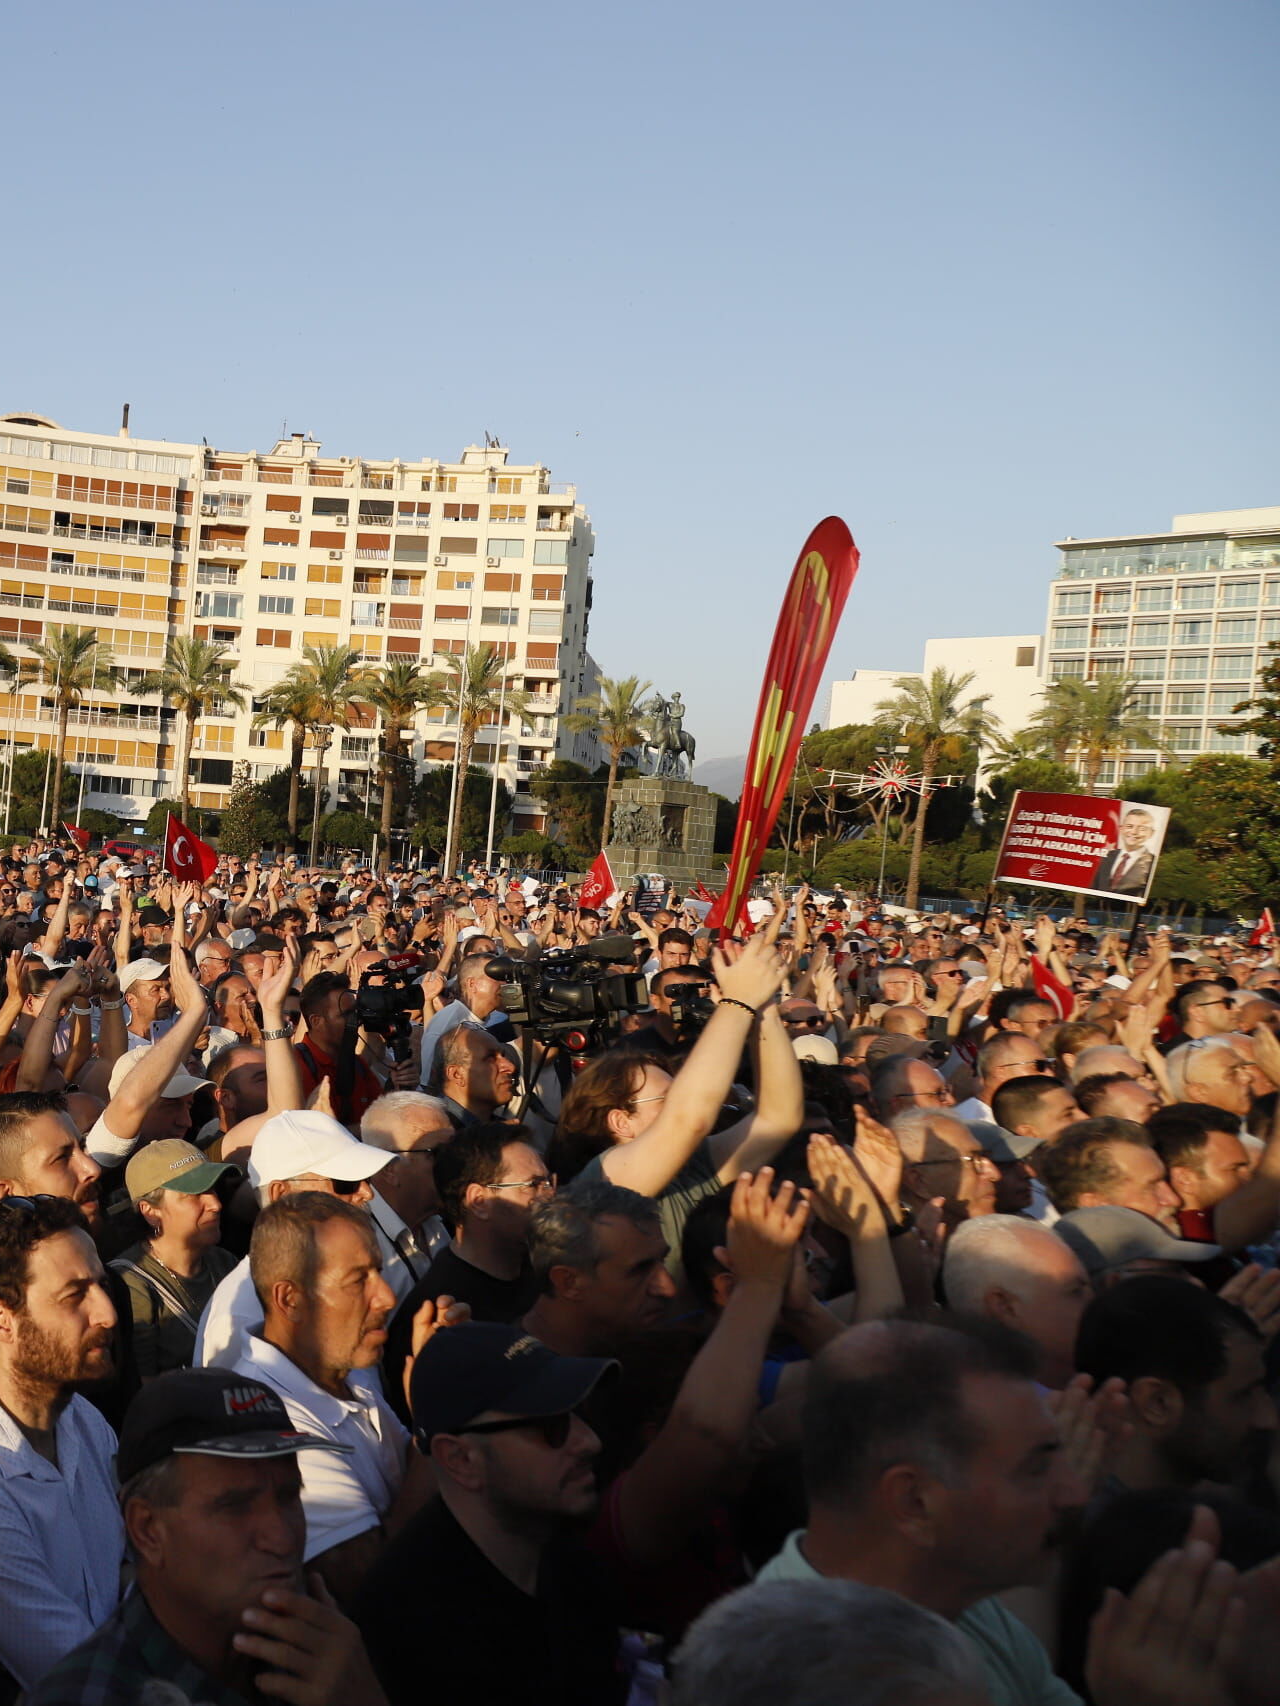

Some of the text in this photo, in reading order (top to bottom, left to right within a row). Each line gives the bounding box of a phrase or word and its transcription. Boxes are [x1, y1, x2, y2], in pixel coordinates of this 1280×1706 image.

[1017, 810, 1045, 822] ÖZGÜR
[1035, 825, 1084, 841] YARINLARI
[1083, 830, 1107, 844] İÇİN
[1042, 840, 1109, 858] ARKADAŞLAR
[584, 883, 603, 898] CHP
[221, 1386, 281, 1416] NIKE
